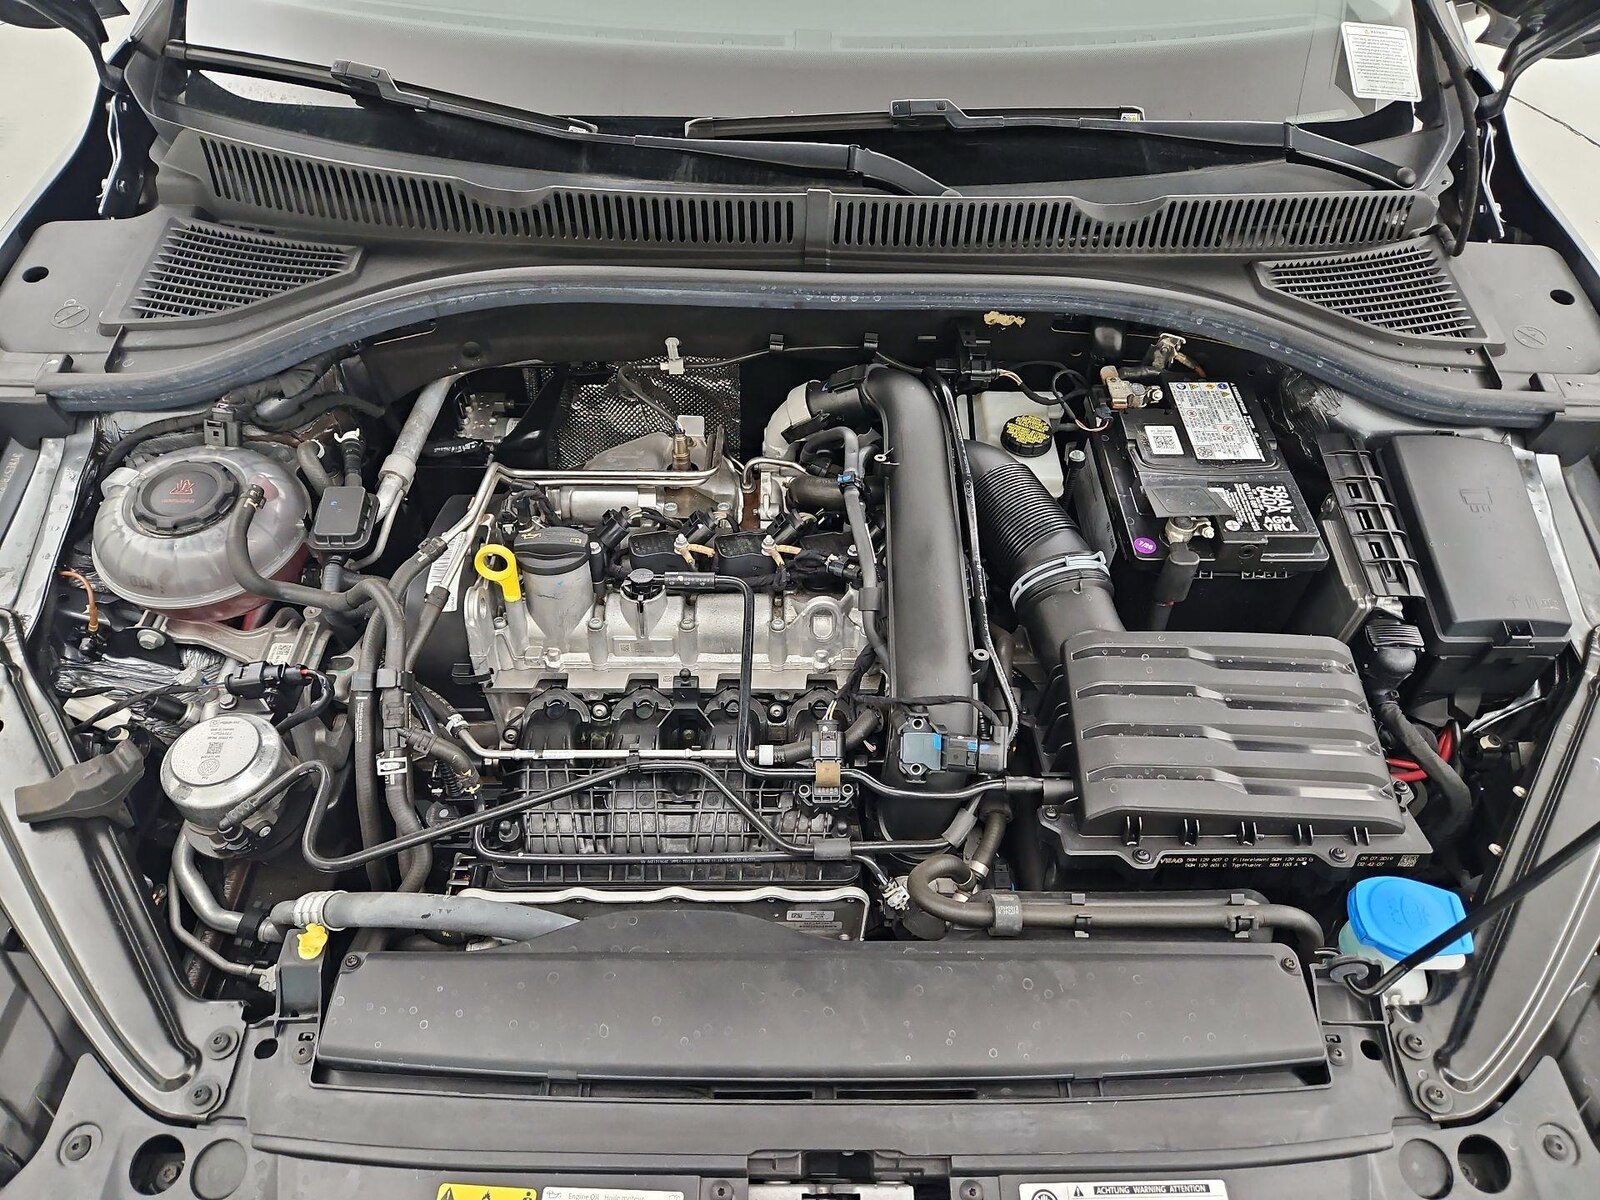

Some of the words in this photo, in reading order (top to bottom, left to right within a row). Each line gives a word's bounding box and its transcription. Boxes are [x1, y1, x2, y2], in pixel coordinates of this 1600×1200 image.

[1264, 515, 1293, 524] AGM
[1263, 523, 1299, 531] VRLA
[1096, 1186, 1130, 1194] ACHTUNG
[1132, 1185, 1167, 1194] WARNING
[1169, 1184, 1206, 1194] ATTENTION
